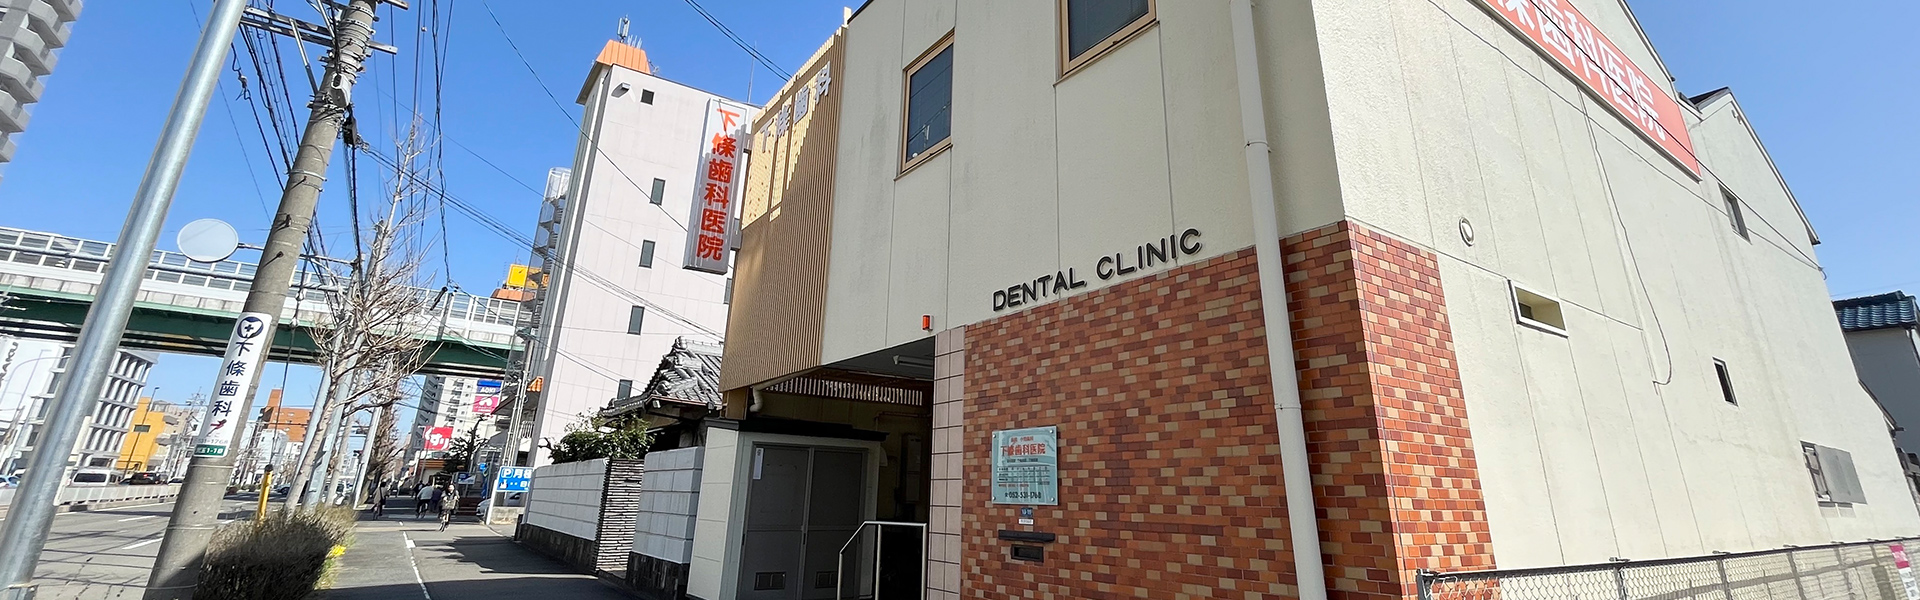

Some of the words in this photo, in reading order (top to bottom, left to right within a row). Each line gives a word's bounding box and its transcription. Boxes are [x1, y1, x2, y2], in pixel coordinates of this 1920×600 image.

[696, 108, 740, 261] 下條歯科医院
[993, 267, 1087, 312] DENTAL
[1096, 228, 1202, 280] CLINIC
[212, 341, 253, 417] 下條歯科
[425, 427, 450, 450] くすり
